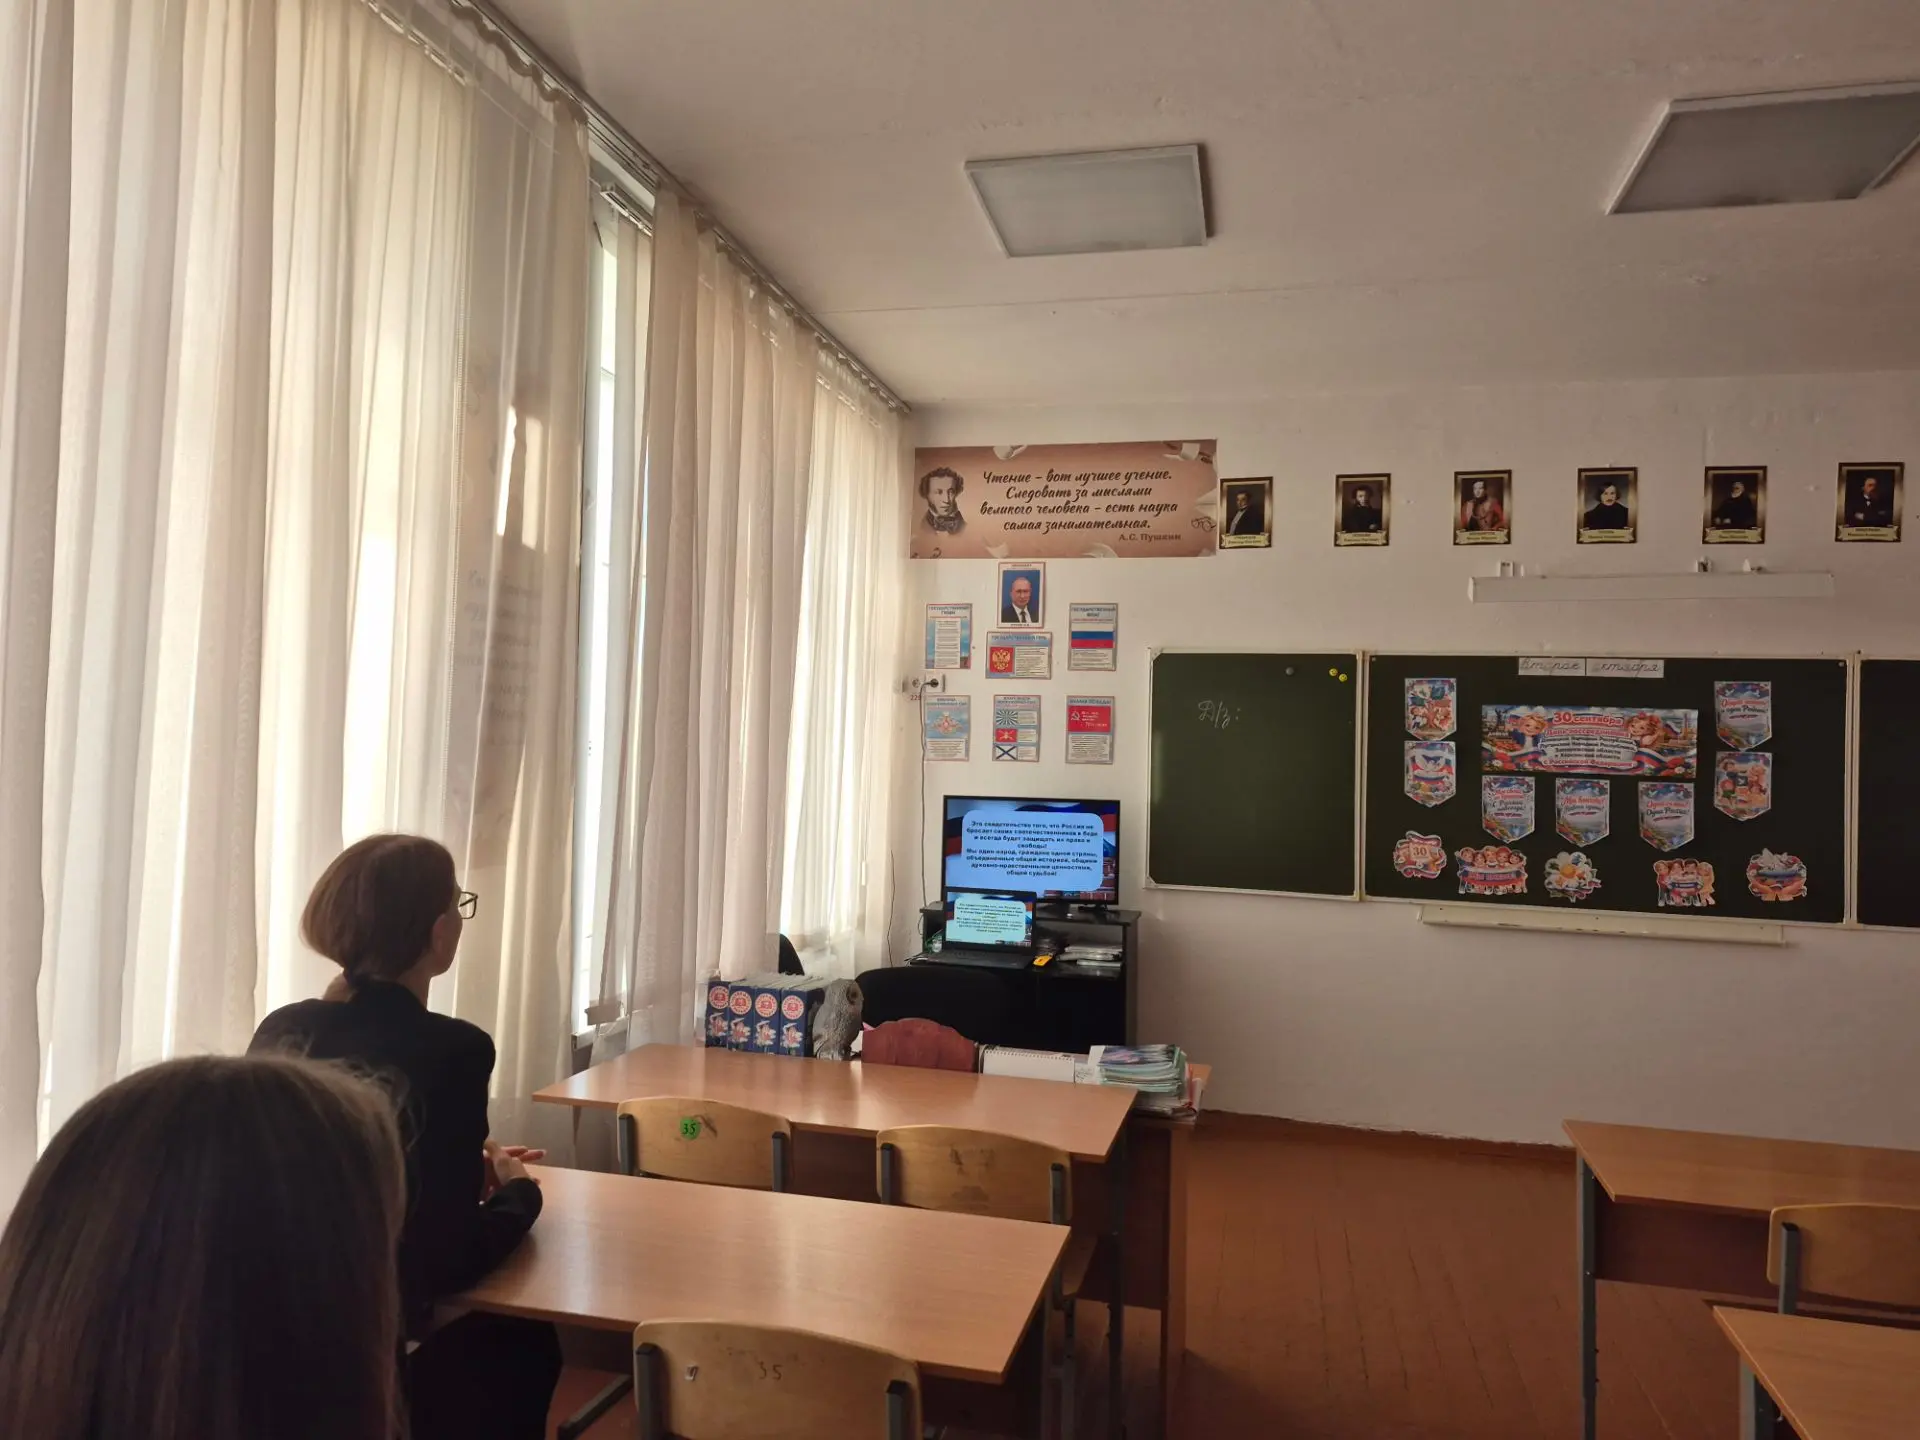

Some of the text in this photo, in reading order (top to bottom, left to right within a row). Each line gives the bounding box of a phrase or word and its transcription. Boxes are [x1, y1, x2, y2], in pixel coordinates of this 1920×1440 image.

[983, 471, 1032, 484] Чтение
[1046, 468, 1072, 482] вот
[1074, 472, 1122, 486] лучшее
[1122, 470, 1172, 486] учение.
[1006, 484, 1072, 503] Следовать
[1071, 488, 1088, 503] за
[980, 501, 1032, 515] великого
[1036, 500, 1090, 514] человека
[1105, 504, 1135, 513] есть
[1138, 503, 1178, 517] наука
[1003, 519, 1150, 535] самая занимательная.
[1119, 533, 1181, 543] А.С. Пушкин
[1553, 711, 1572, 723] 30
[1412, 847, 1427, 856] 30
[680, 1123, 697, 1136] 35
